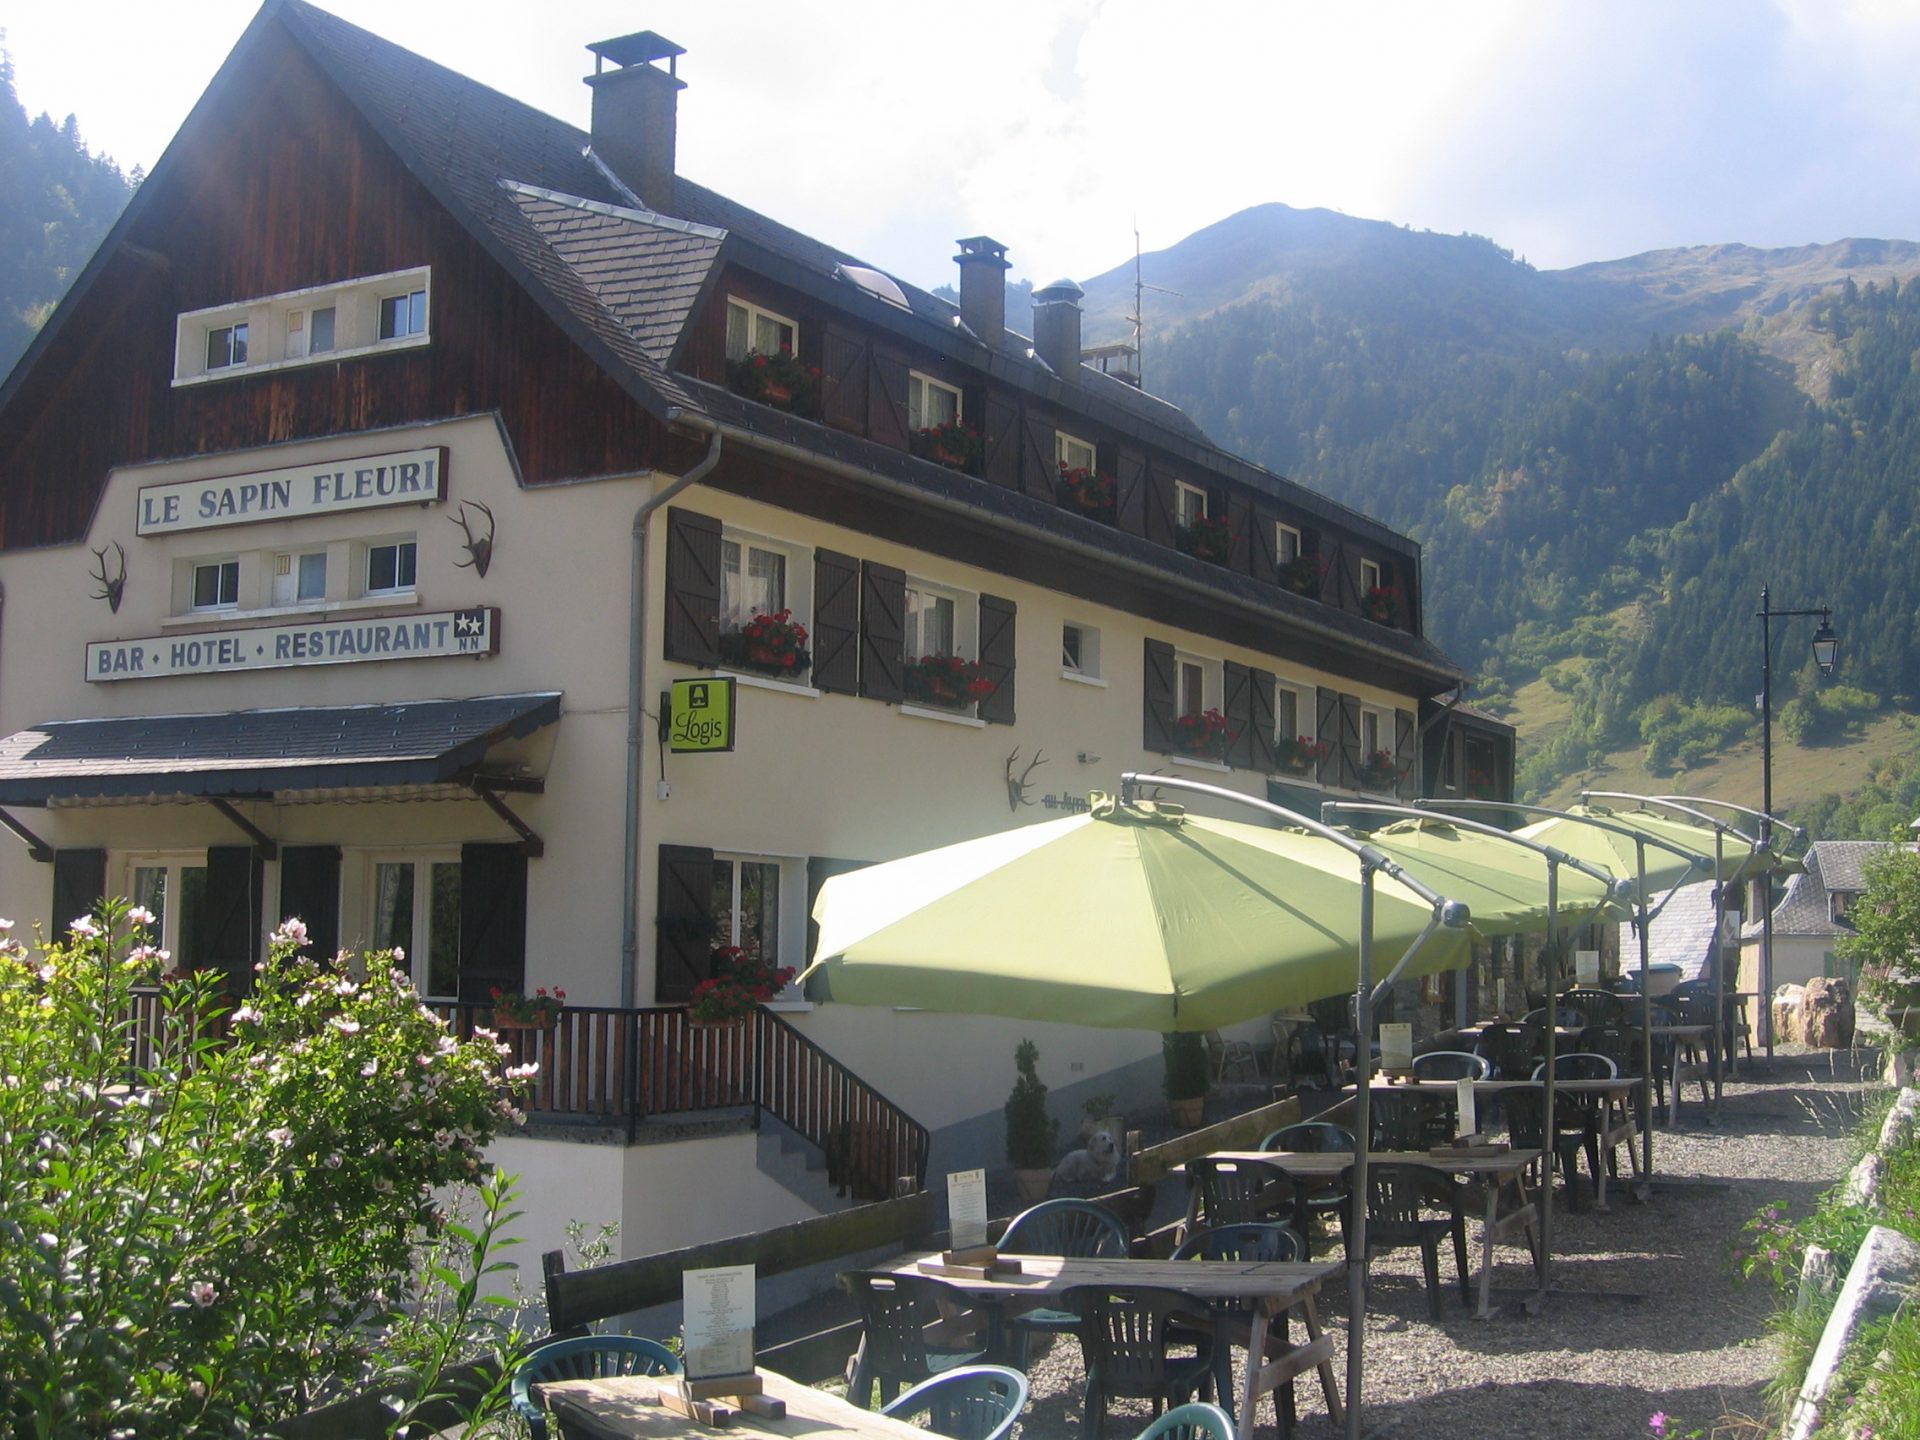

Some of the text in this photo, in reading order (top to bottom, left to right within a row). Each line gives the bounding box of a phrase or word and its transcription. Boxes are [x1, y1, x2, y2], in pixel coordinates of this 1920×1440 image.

[142, 460, 435, 526] LE SAPIN FLEURI
[98, 621, 449, 674] BAR HOTEL RESTAURANT
[459, 637, 479, 650] NN
[672, 710, 722, 745] Logis
